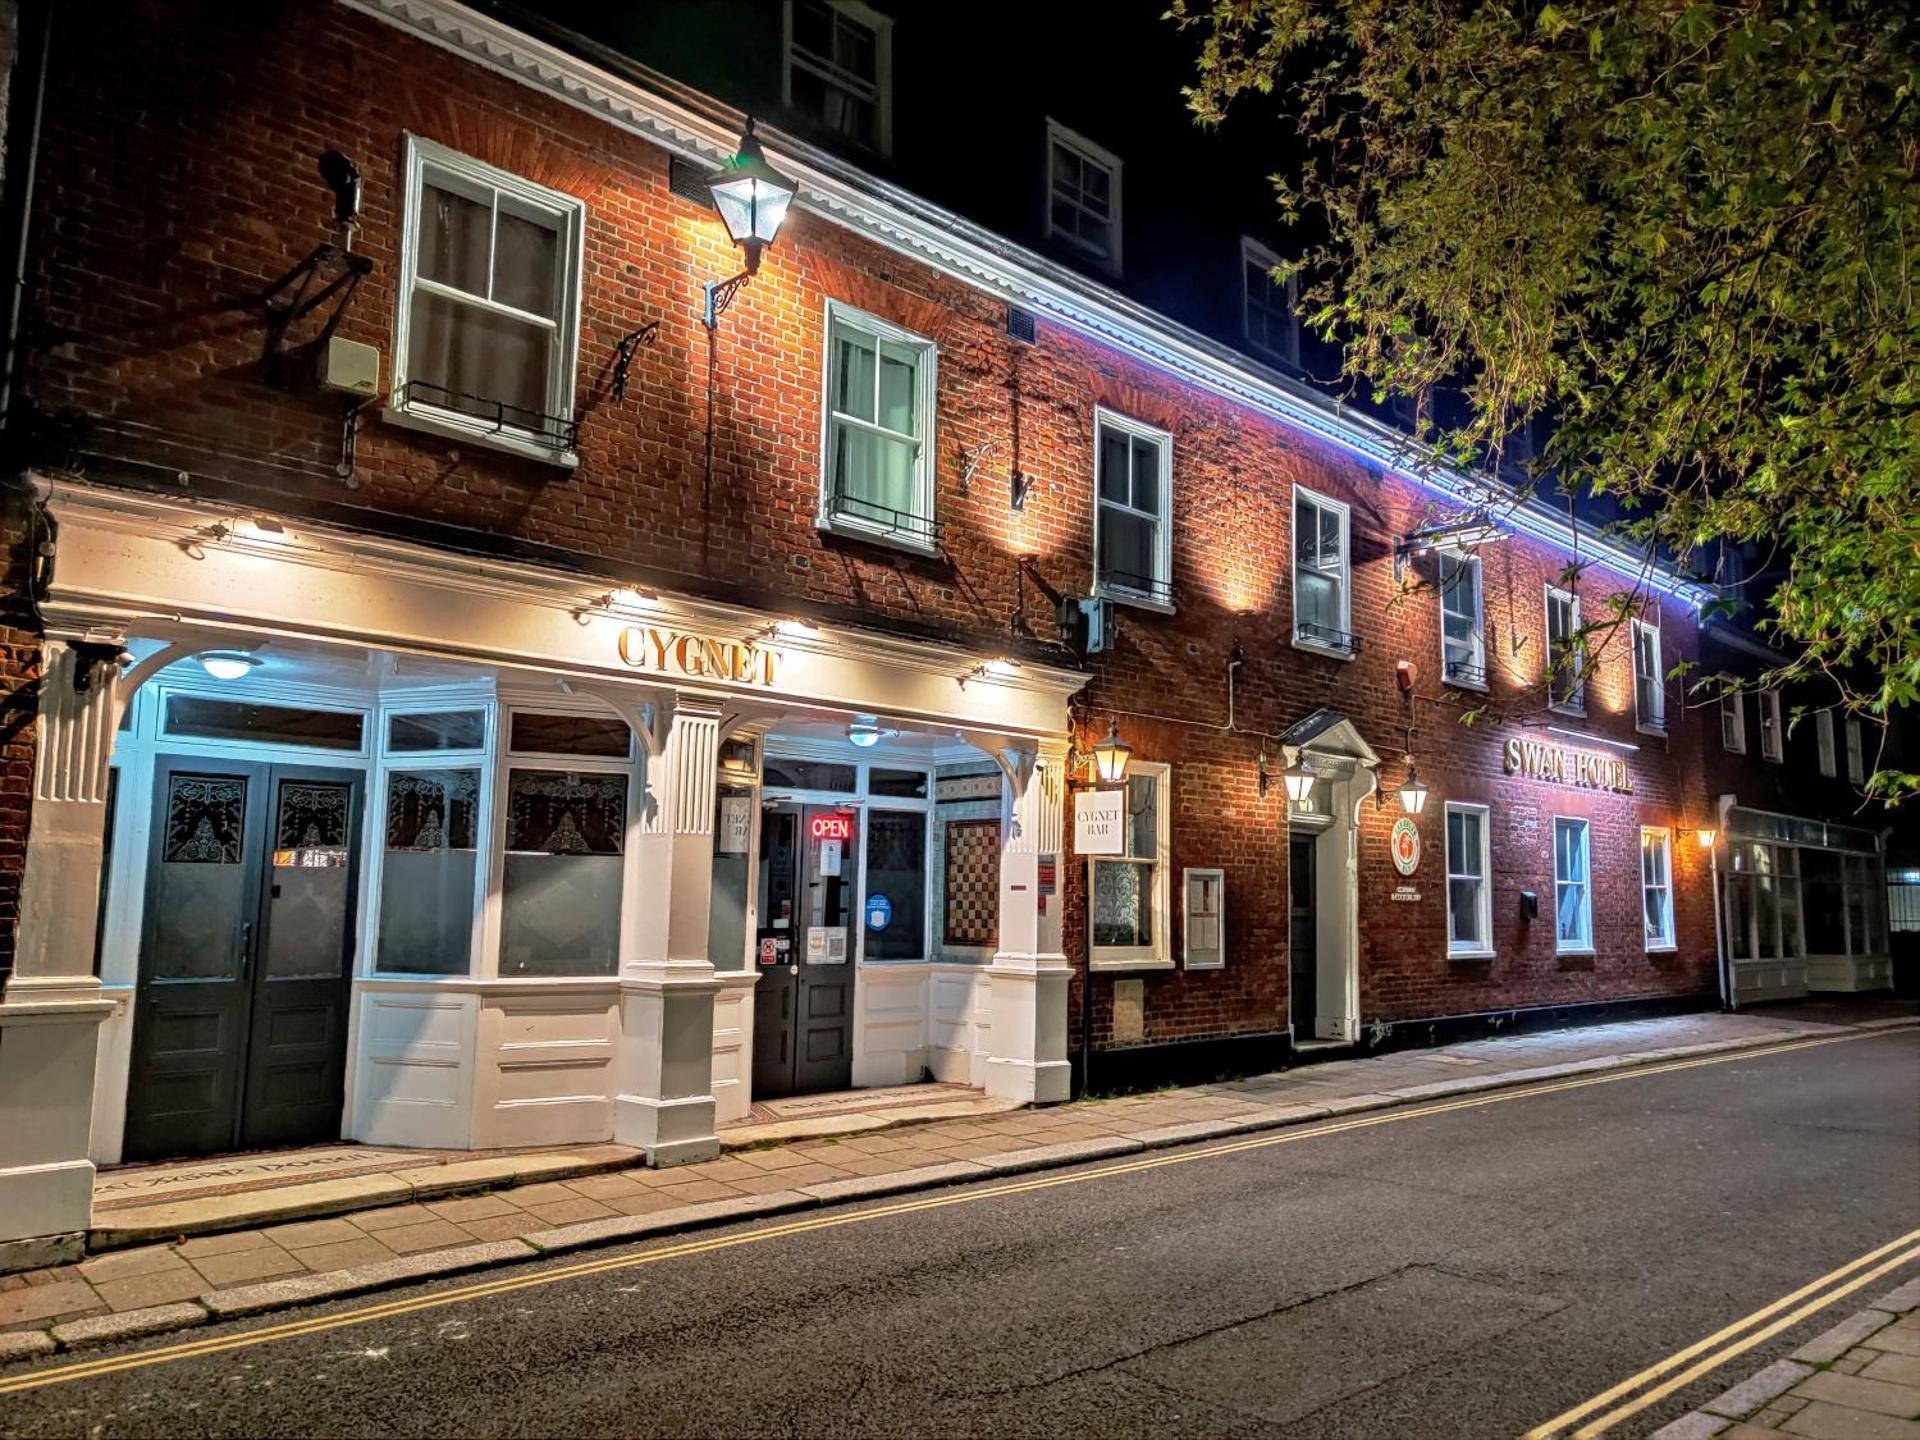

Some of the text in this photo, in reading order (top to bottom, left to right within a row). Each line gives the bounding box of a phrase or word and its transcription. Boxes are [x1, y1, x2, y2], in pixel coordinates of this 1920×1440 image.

[618, 626, 783, 687] CYGNET
[1504, 738, 1633, 792] SWAN HOTEL
[1077, 809, 1119, 822] CYGNET
[812, 819, 848, 837] OPEN
[1087, 823, 1109, 835] BAR
